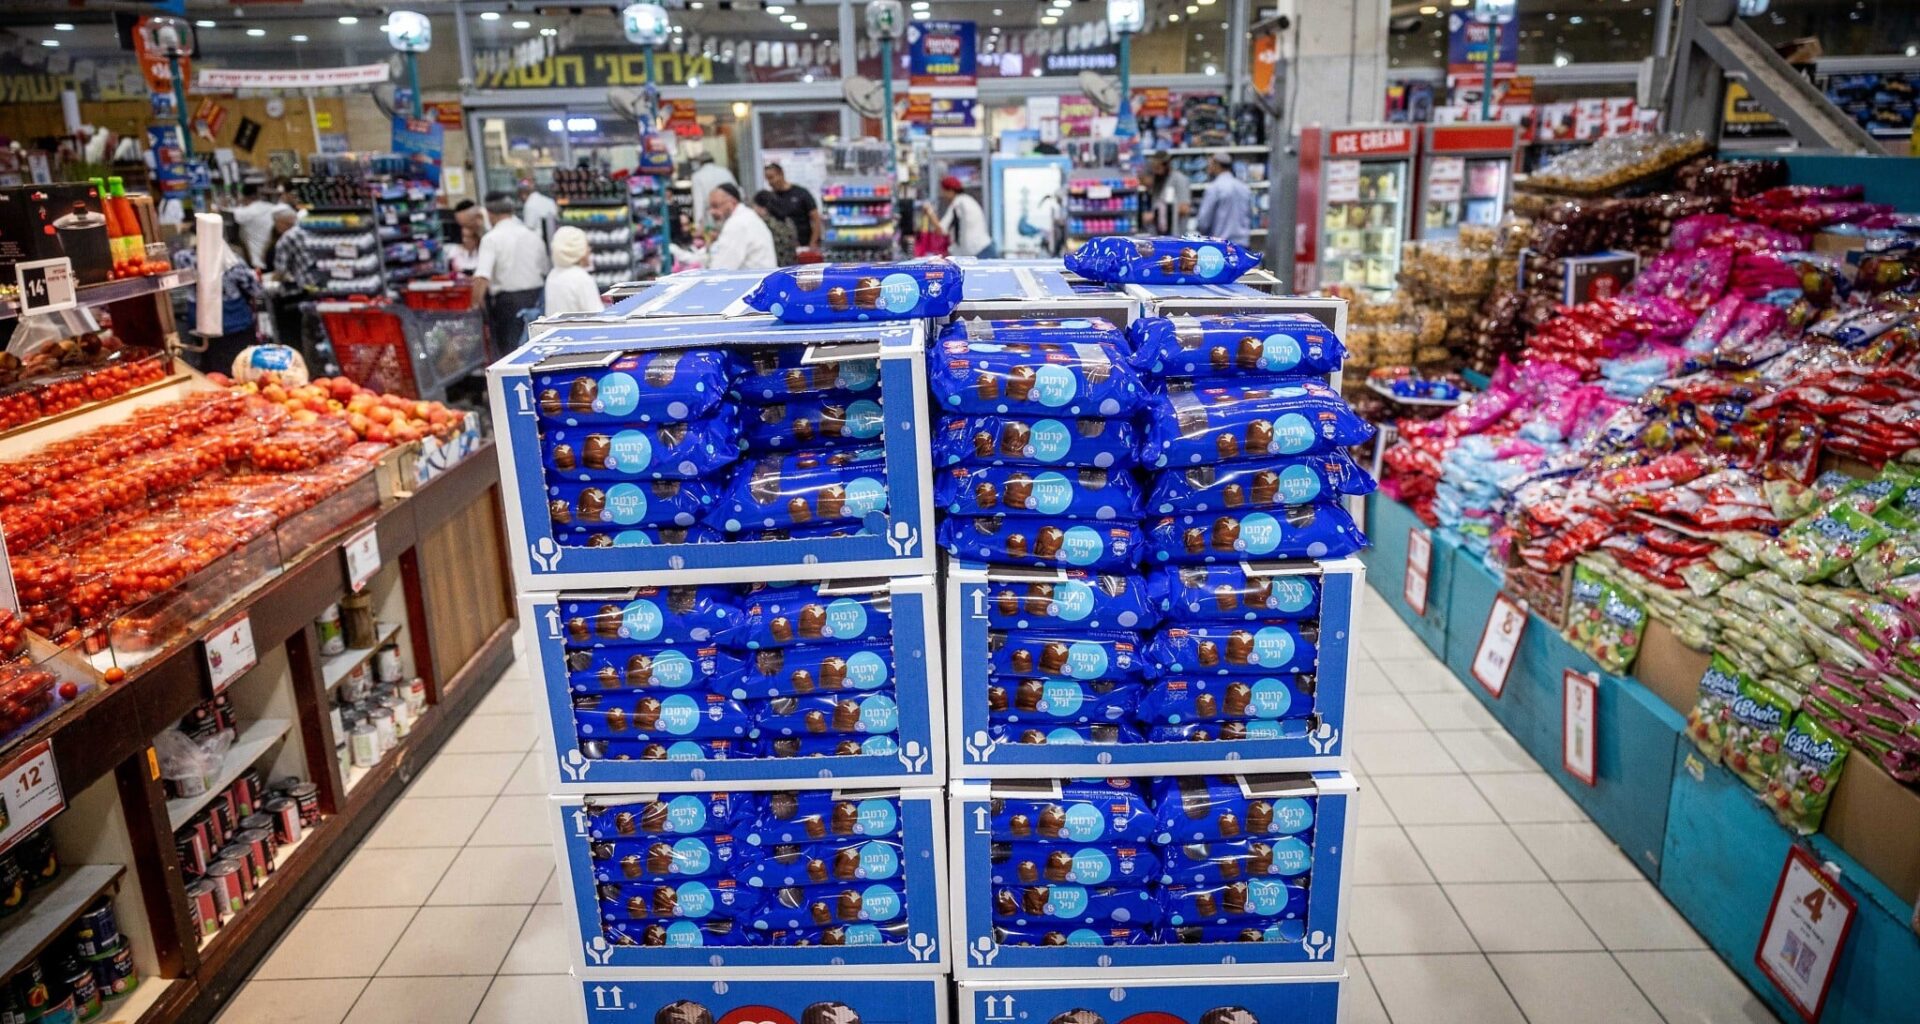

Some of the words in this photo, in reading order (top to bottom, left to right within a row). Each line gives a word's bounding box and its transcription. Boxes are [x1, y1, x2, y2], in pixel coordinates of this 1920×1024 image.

[1047, 54, 1116, 69] SAMSUNG
[595, 52, 713, 84] מחסני
[1335, 134, 1359, 153] ICE
[1360, 129, 1406, 150] CREAM
[28, 279, 45, 297] 14
[1267, 346, 1293, 357] קרמבו
[1273, 354, 1288, 364] וניל
[1041, 376, 1068, 388] קרמבו
[603, 385, 630, 396] קרמבו
[1046, 386, 1062, 396] וניל
[610, 395, 626, 405] וניל
[1035, 432, 1062, 443] קרמבו
[1285, 435, 1302, 447] וניל
[616, 442, 642, 453] קרמבו
[1040, 442, 1056, 452] וניל
[622, 452, 638, 463] וניל
[1284, 477, 1311, 489] קרמבו
[1037, 484, 1065, 496] קרמבו
[1290, 487, 1306, 498] וניל
[611, 496, 638, 507] קרמבו
[857, 499, 873, 510] וניל
[1043, 494, 1059, 504] וניל
[616, 504, 633, 515] וניל
[1245, 525, 1272, 537] קרמבו
[1068, 538, 1095, 550] קרמבו
[1073, 548, 1089, 558] וניל
[1058, 591, 1084, 603] קרמבו
[1064, 600, 1080, 611] וניל
[628, 611, 654, 623] קרמבו
[831, 611, 859, 623] קרמבו
[634, 621, 650, 632] וניל
[837, 620, 854, 631] וניל
[232, 630, 240, 645] 4
[1258, 639, 1286, 651] קרמבו
[1072, 652, 1099, 664] קרמבו
[1264, 648, 1280, 659] וניל
[657, 661, 684, 673] קרמבו
[851, 664, 878, 674] קרמבו
[1078, 661, 1095, 672] וניל
[664, 671, 680, 681] וניל
[857, 673, 874, 682] וניל
[1048, 688, 1074, 699] קרמבו
[1255, 690, 1283, 703] קרמבו
[1054, 697, 1069, 707] וניל
[1262, 699, 1278, 710] וניל
[665, 707, 692, 718] קרמבו
[865, 707, 891, 719] קרמבו
[671, 716, 688, 726] וניל
[870, 717, 887, 727] וניל
[18, 765, 42, 793] 12
[672, 807, 698, 819] קרמבו
[861, 809, 888, 820] קרמבו
[677, 816, 693, 826] וניל
[867, 818, 884, 829] וניל
[1070, 816, 1096, 827] קרמבו
[1283, 816, 1300, 827] וניל
[1075, 825, 1092, 834] וניל
[864, 854, 890, 864] קרמבו
[1277, 850, 1304, 860] קרמבו
[684, 859, 699, 868] וניל
[870, 862, 886, 872] וניל
[1077, 861, 1103, 871] קרמבו
[1284, 859, 1300, 868] וניל
[1082, 869, 1098, 878] וניל
[1053, 890, 1080, 901] קרמבו
[1253, 887, 1279, 897] קרמבו
[680, 894, 705, 904] קרמבו
[866, 896, 892, 906] קרמבו
[1059, 899, 1075, 909] וניל
[1259, 895, 1276, 906] וניל
[687, 901, 703, 910] וניל
[871, 904, 888, 914] וניל
[1803, 887, 1827, 924] 4
[671, 932, 696, 943] קרמבו
[850, 934, 875, 943] קרמבו
